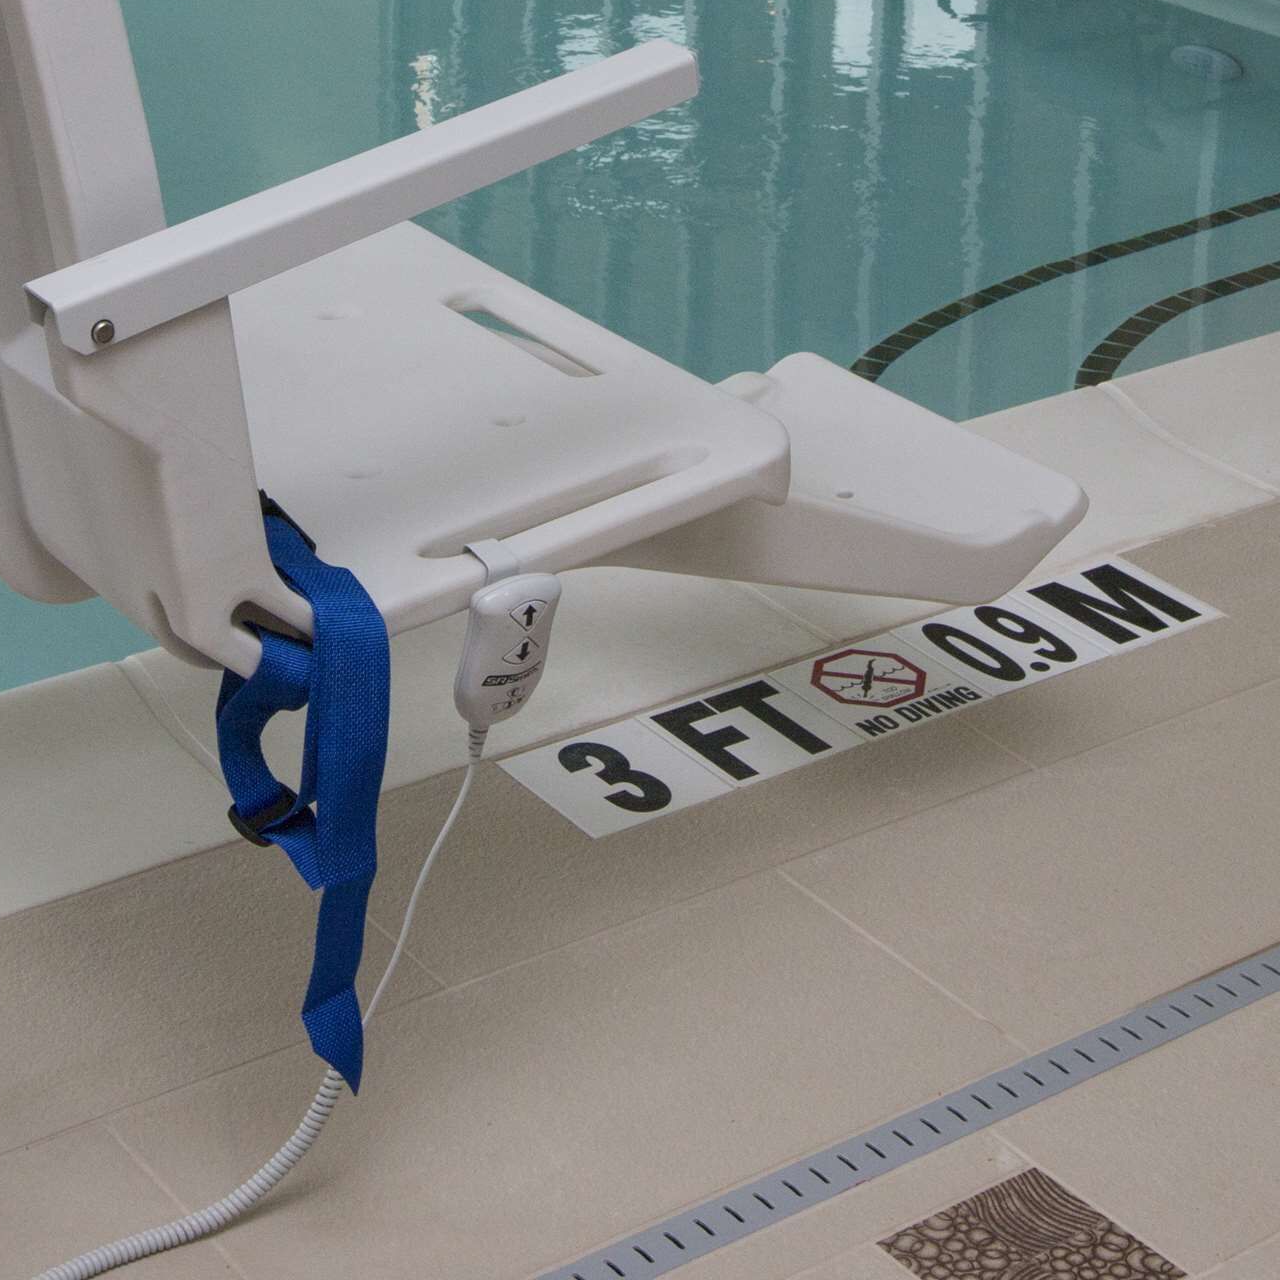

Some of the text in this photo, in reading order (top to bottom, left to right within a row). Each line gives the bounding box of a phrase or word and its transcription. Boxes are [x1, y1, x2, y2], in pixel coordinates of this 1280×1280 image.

[921, 563, 1203, 682] 0.9 M
[558, 679, 833, 813] 3 FT
[856, 686, 982, 737] NO DIVING
